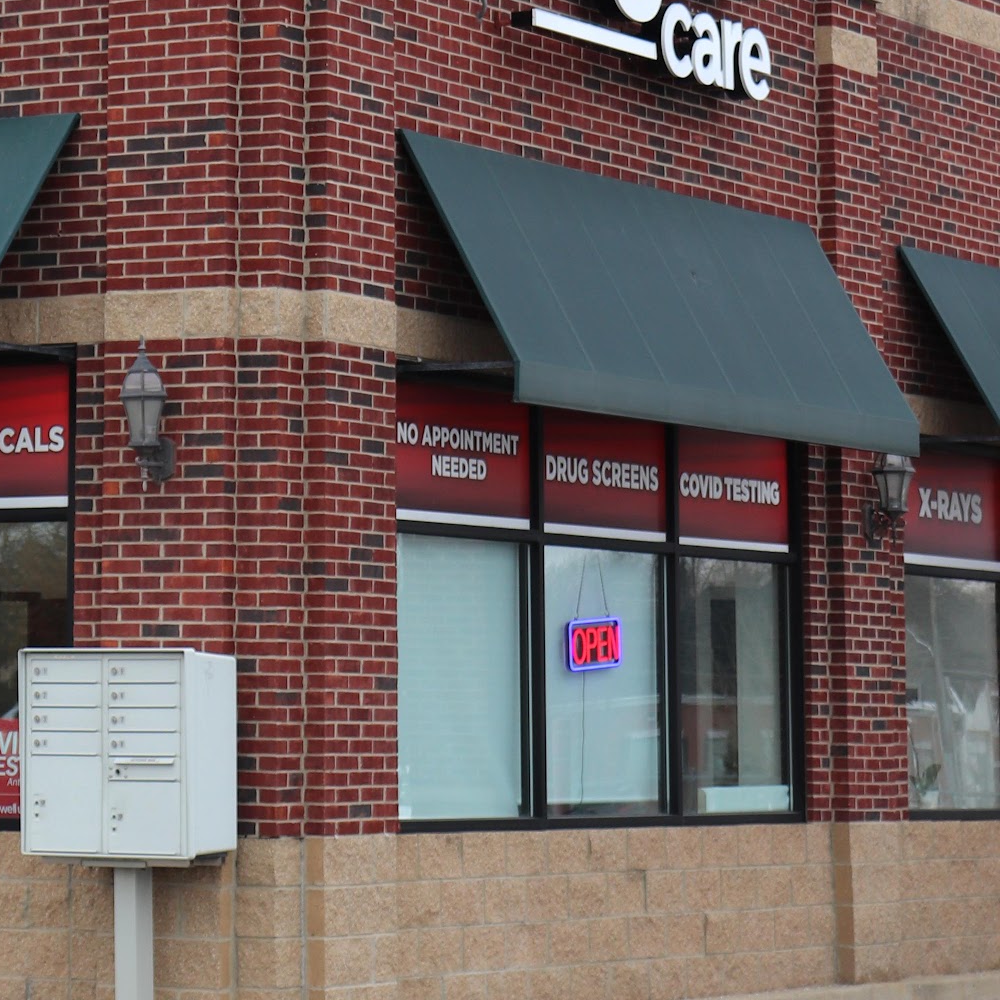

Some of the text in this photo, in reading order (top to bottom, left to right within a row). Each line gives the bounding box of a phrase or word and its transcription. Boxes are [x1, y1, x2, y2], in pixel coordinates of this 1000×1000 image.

[661, 2, 772, 101] care
[397, 421, 519, 456] NO APPOINTMENT
[431, 454, 487, 481] NEEDED
[545, 454, 659, 492] DRUG SCREENS
[679, 472, 780, 506] COVID TESTING
[918, 487, 983, 525] X-RAYS
[572, 625, 620, 665] OPEN
